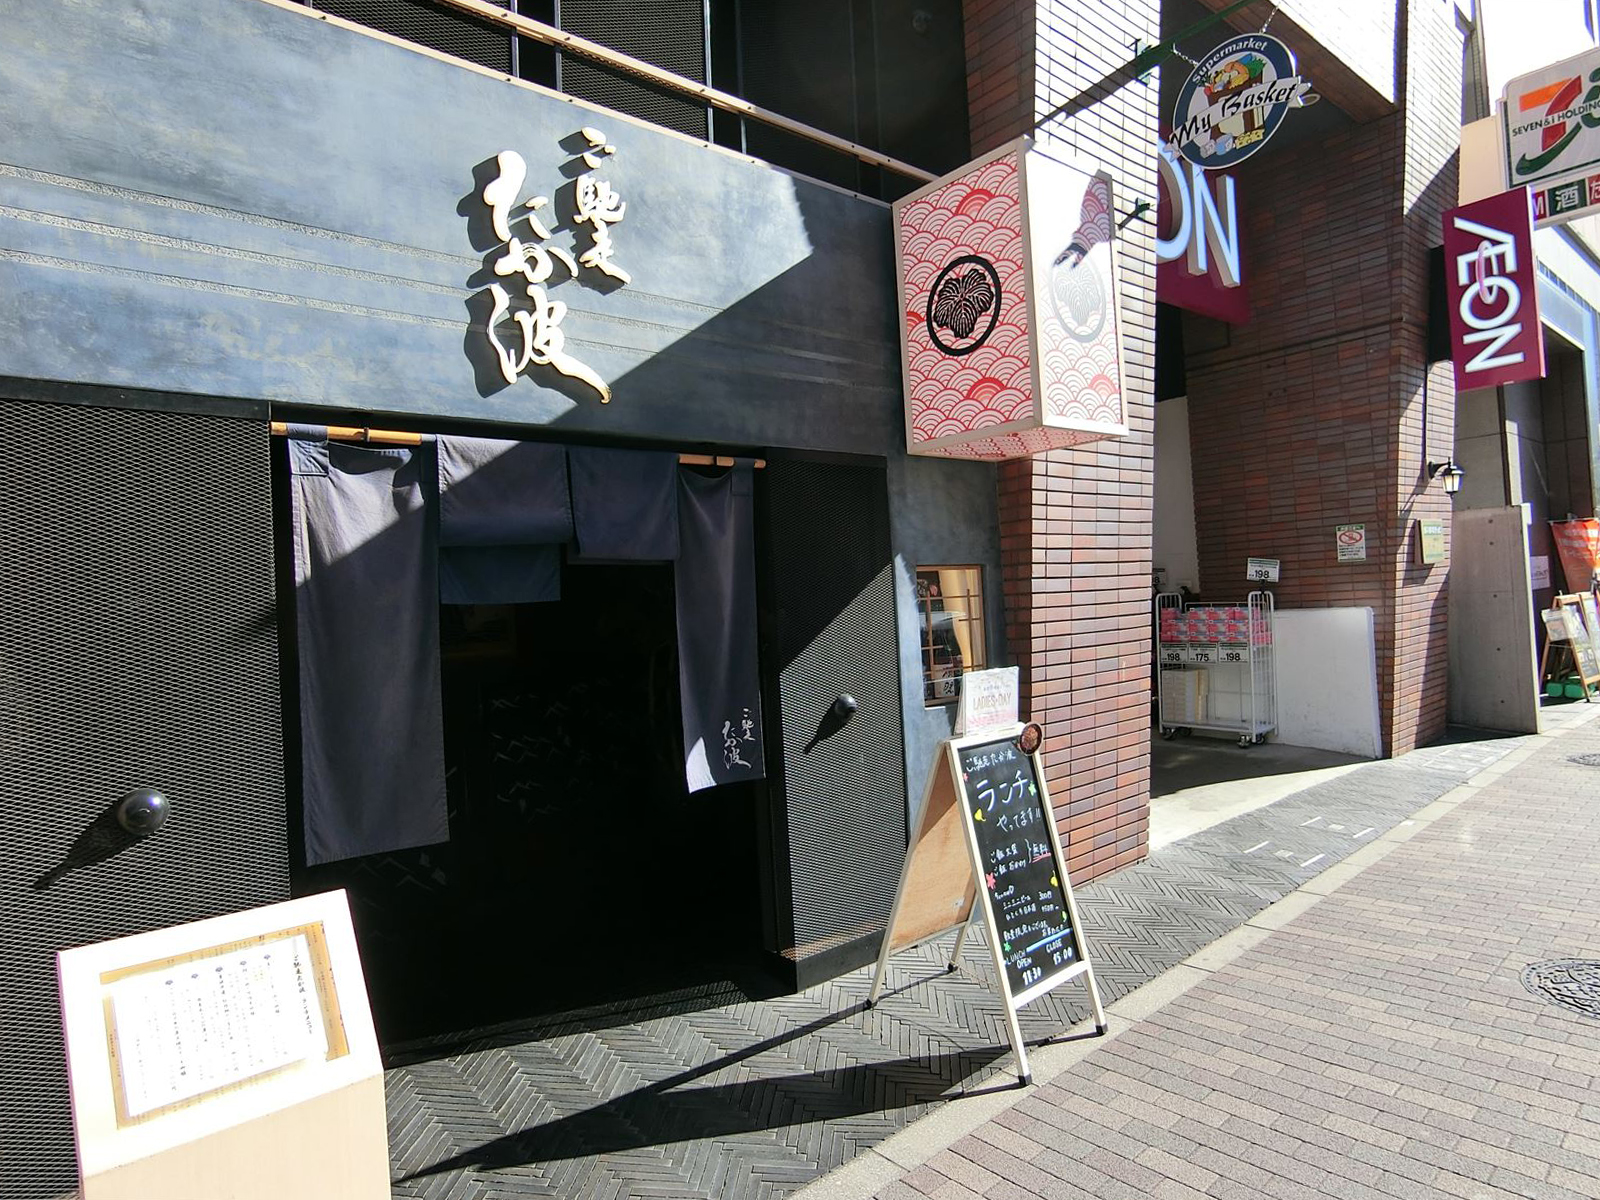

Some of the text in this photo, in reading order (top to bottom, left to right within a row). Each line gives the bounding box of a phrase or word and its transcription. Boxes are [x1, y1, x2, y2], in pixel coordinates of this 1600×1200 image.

[1170, 81, 1297, 148] My Basket
[1555, 185, 1579, 211] 酒
[484, 150, 613, 404] たか波
[1254, 569, 1270, 579] 198
[1166, 652, 1181, 661] 198
[1195, 653, 1209, 662] 175
[1225, 652, 1241, 661] 198
[976, 769, 1028, 812] ランチ
